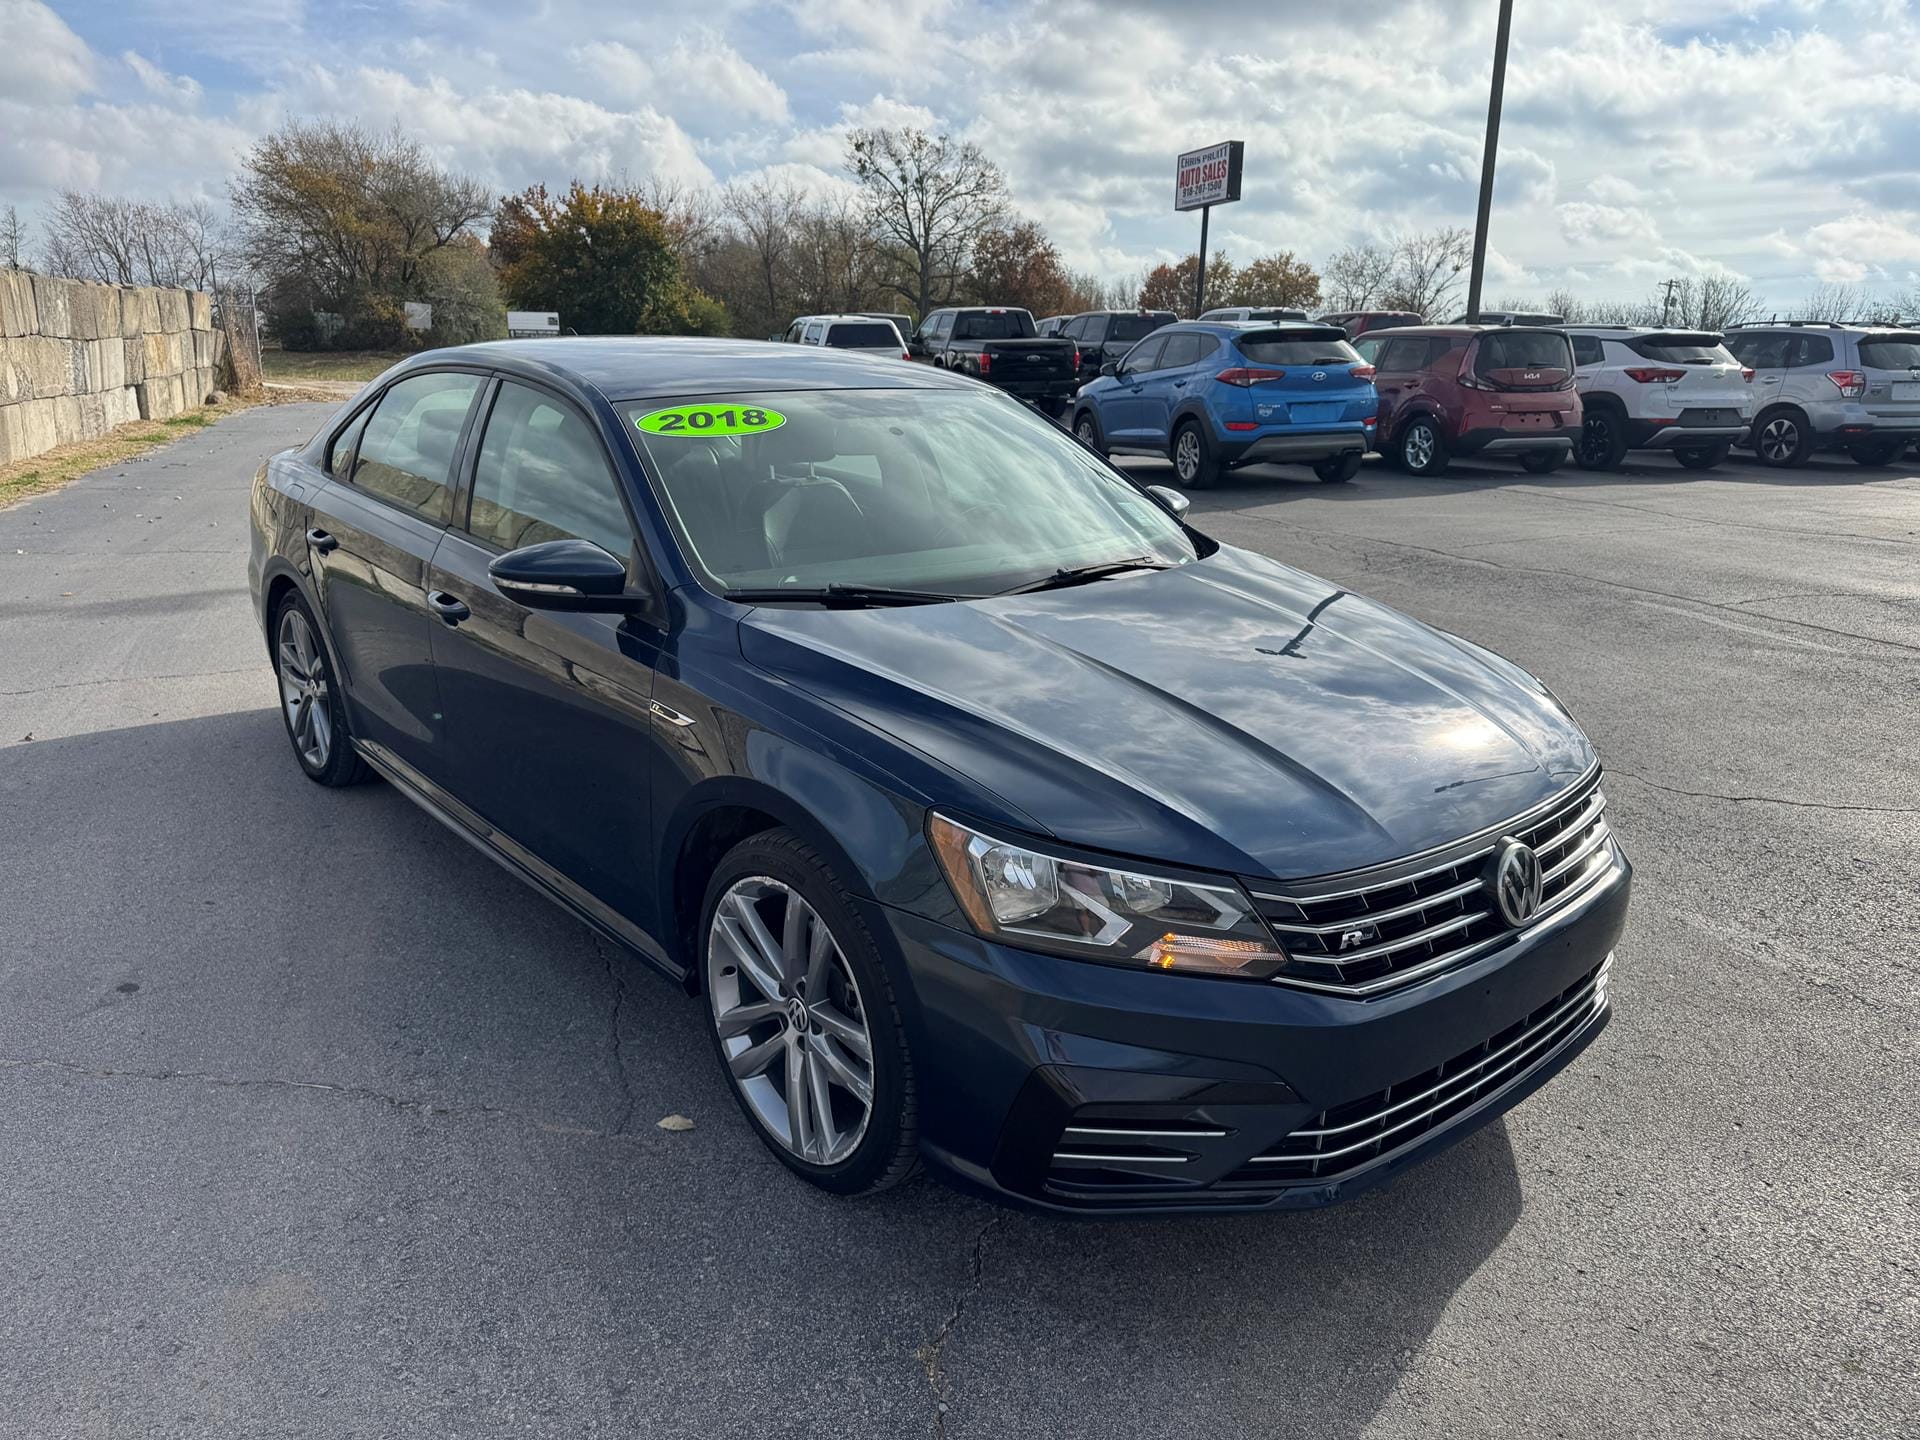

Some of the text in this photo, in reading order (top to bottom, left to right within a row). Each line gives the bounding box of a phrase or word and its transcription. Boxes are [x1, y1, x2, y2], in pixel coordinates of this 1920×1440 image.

[1179, 159, 1228, 189] AUTO SALES
[1181, 156, 1201, 169] CHRIS
[658, 409, 768, 432] 2018
